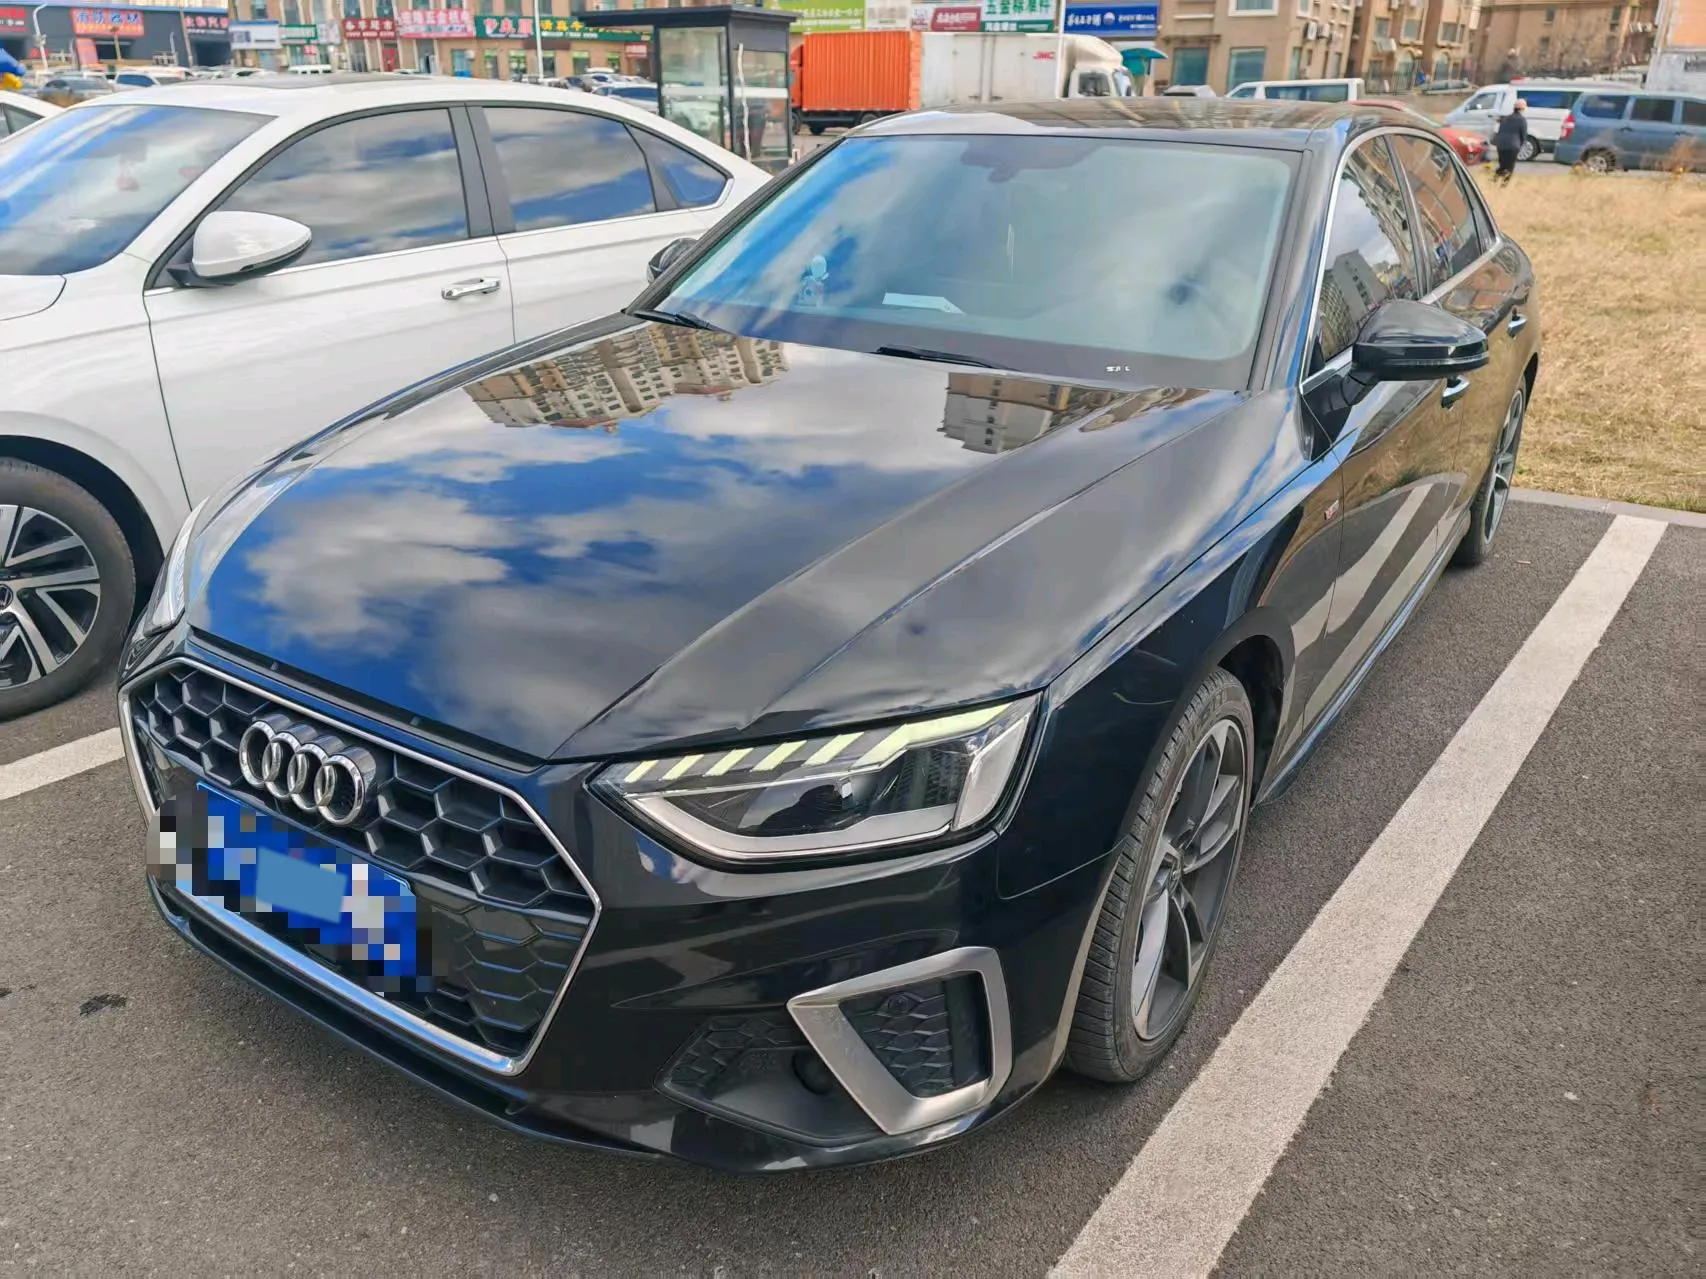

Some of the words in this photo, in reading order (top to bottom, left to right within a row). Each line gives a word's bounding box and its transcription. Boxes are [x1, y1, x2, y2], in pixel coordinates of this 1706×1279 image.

[984, 0, 1051, 14] 五金标准件
[1033, 51, 1056, 60] JMC
